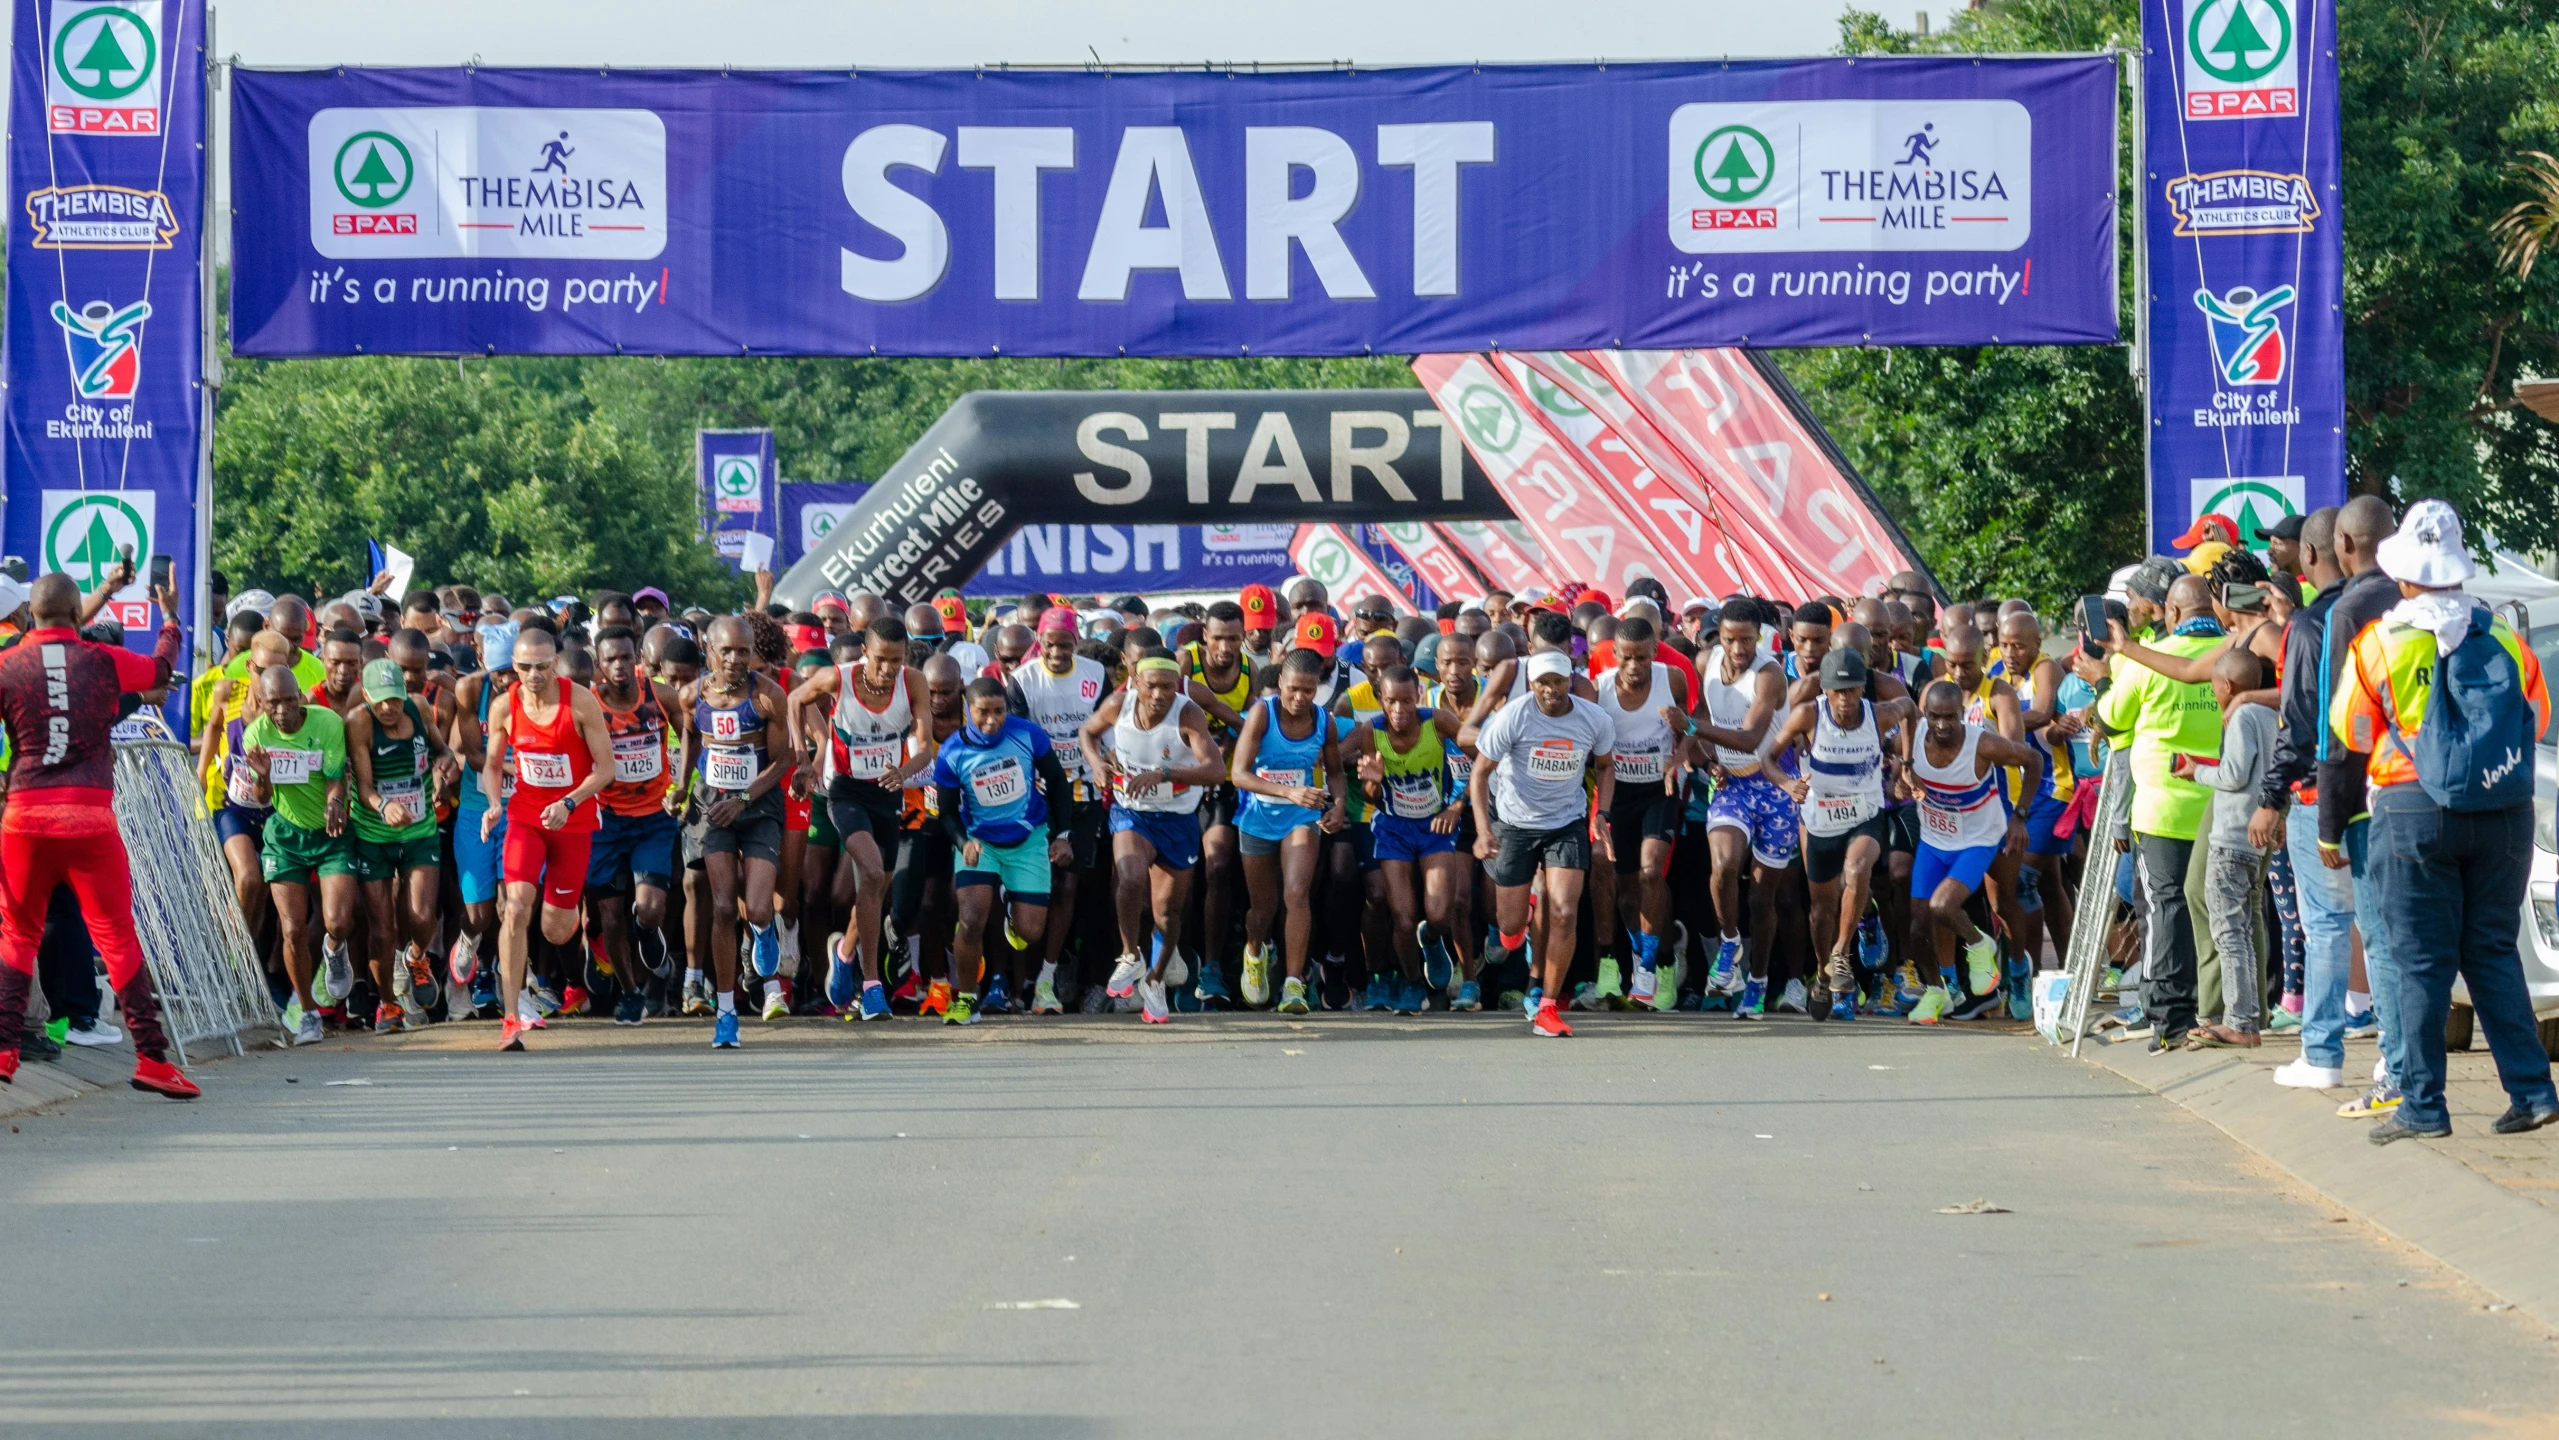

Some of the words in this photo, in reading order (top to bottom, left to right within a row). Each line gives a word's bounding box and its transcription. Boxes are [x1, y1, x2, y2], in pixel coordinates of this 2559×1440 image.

[2190, 90, 2293, 115] SPAR
[53, 107, 155, 131] SPAR
[458, 177, 645, 210] THEMBISA
[1821, 170, 2009, 201] THEMBISA
[2174, 176, 2313, 211] THEMBISA
[34, 192, 171, 228] THEMBISA
[840, 120, 1495, 301] START
[1693, 210, 1776, 228] SPAR
[1881, 205, 1946, 230] MILE
[2197, 211, 2259, 224] ATHLETICS
[2261, 209, 2292, 221] CLUB
[56, 225, 117, 237] ATHLETICS
[119, 225, 150, 237] CLUB
[334, 215, 416, 233] SPAR
[519, 214, 583, 238] MILE
[309, 265, 361, 303] it's
[373, 276, 397, 303] a
[411, 268, 549, 312] running
[562, 266, 670, 314] party!
[1667, 260, 1720, 298] it's
[1732, 271, 1756, 298] a
[1770, 262, 1912, 305] running
[1924, 258, 2032, 306] party!
[2211, 391, 2252, 410] City
[2256, 390, 2279, 409] of
[65, 403, 105, 423] City
[109, 403, 132, 422] of
[2193, 405, 2301, 427] Ekurhuleni
[46, 420, 153, 439] Ekurhuleni
[1073, 410, 1465, 506] START
[918, 476, 984, 538] Mile
[820, 446, 960, 589] Ekurhuleni
[886, 499, 1006, 605] ERIES
[1224, 555, 1234, 566] a
[1237, 551, 1287, 568] running
[45, 667, 70, 711] FAT
[1081, 679, 1098, 700] 60
[2172, 700, 2218, 712] running
[717, 716, 736, 736] 50
[621, 752, 649, 761] SPAR
[715, 755, 742, 765] SPAR
[1531, 757, 1580, 772] THABANG
[1542, 751, 1571, 760] SPAR
[273, 759, 298, 775] 1271
[526, 764, 566, 780] 1944
[624, 758, 653, 775] 1425
[713, 763, 748, 781] SIPHO
[1613, 761, 1662, 776] SAMUEL
[987, 778, 1015, 799] 1307
[1827, 805, 1858, 822] 1494
[1923, 810, 1958, 834] 1885
